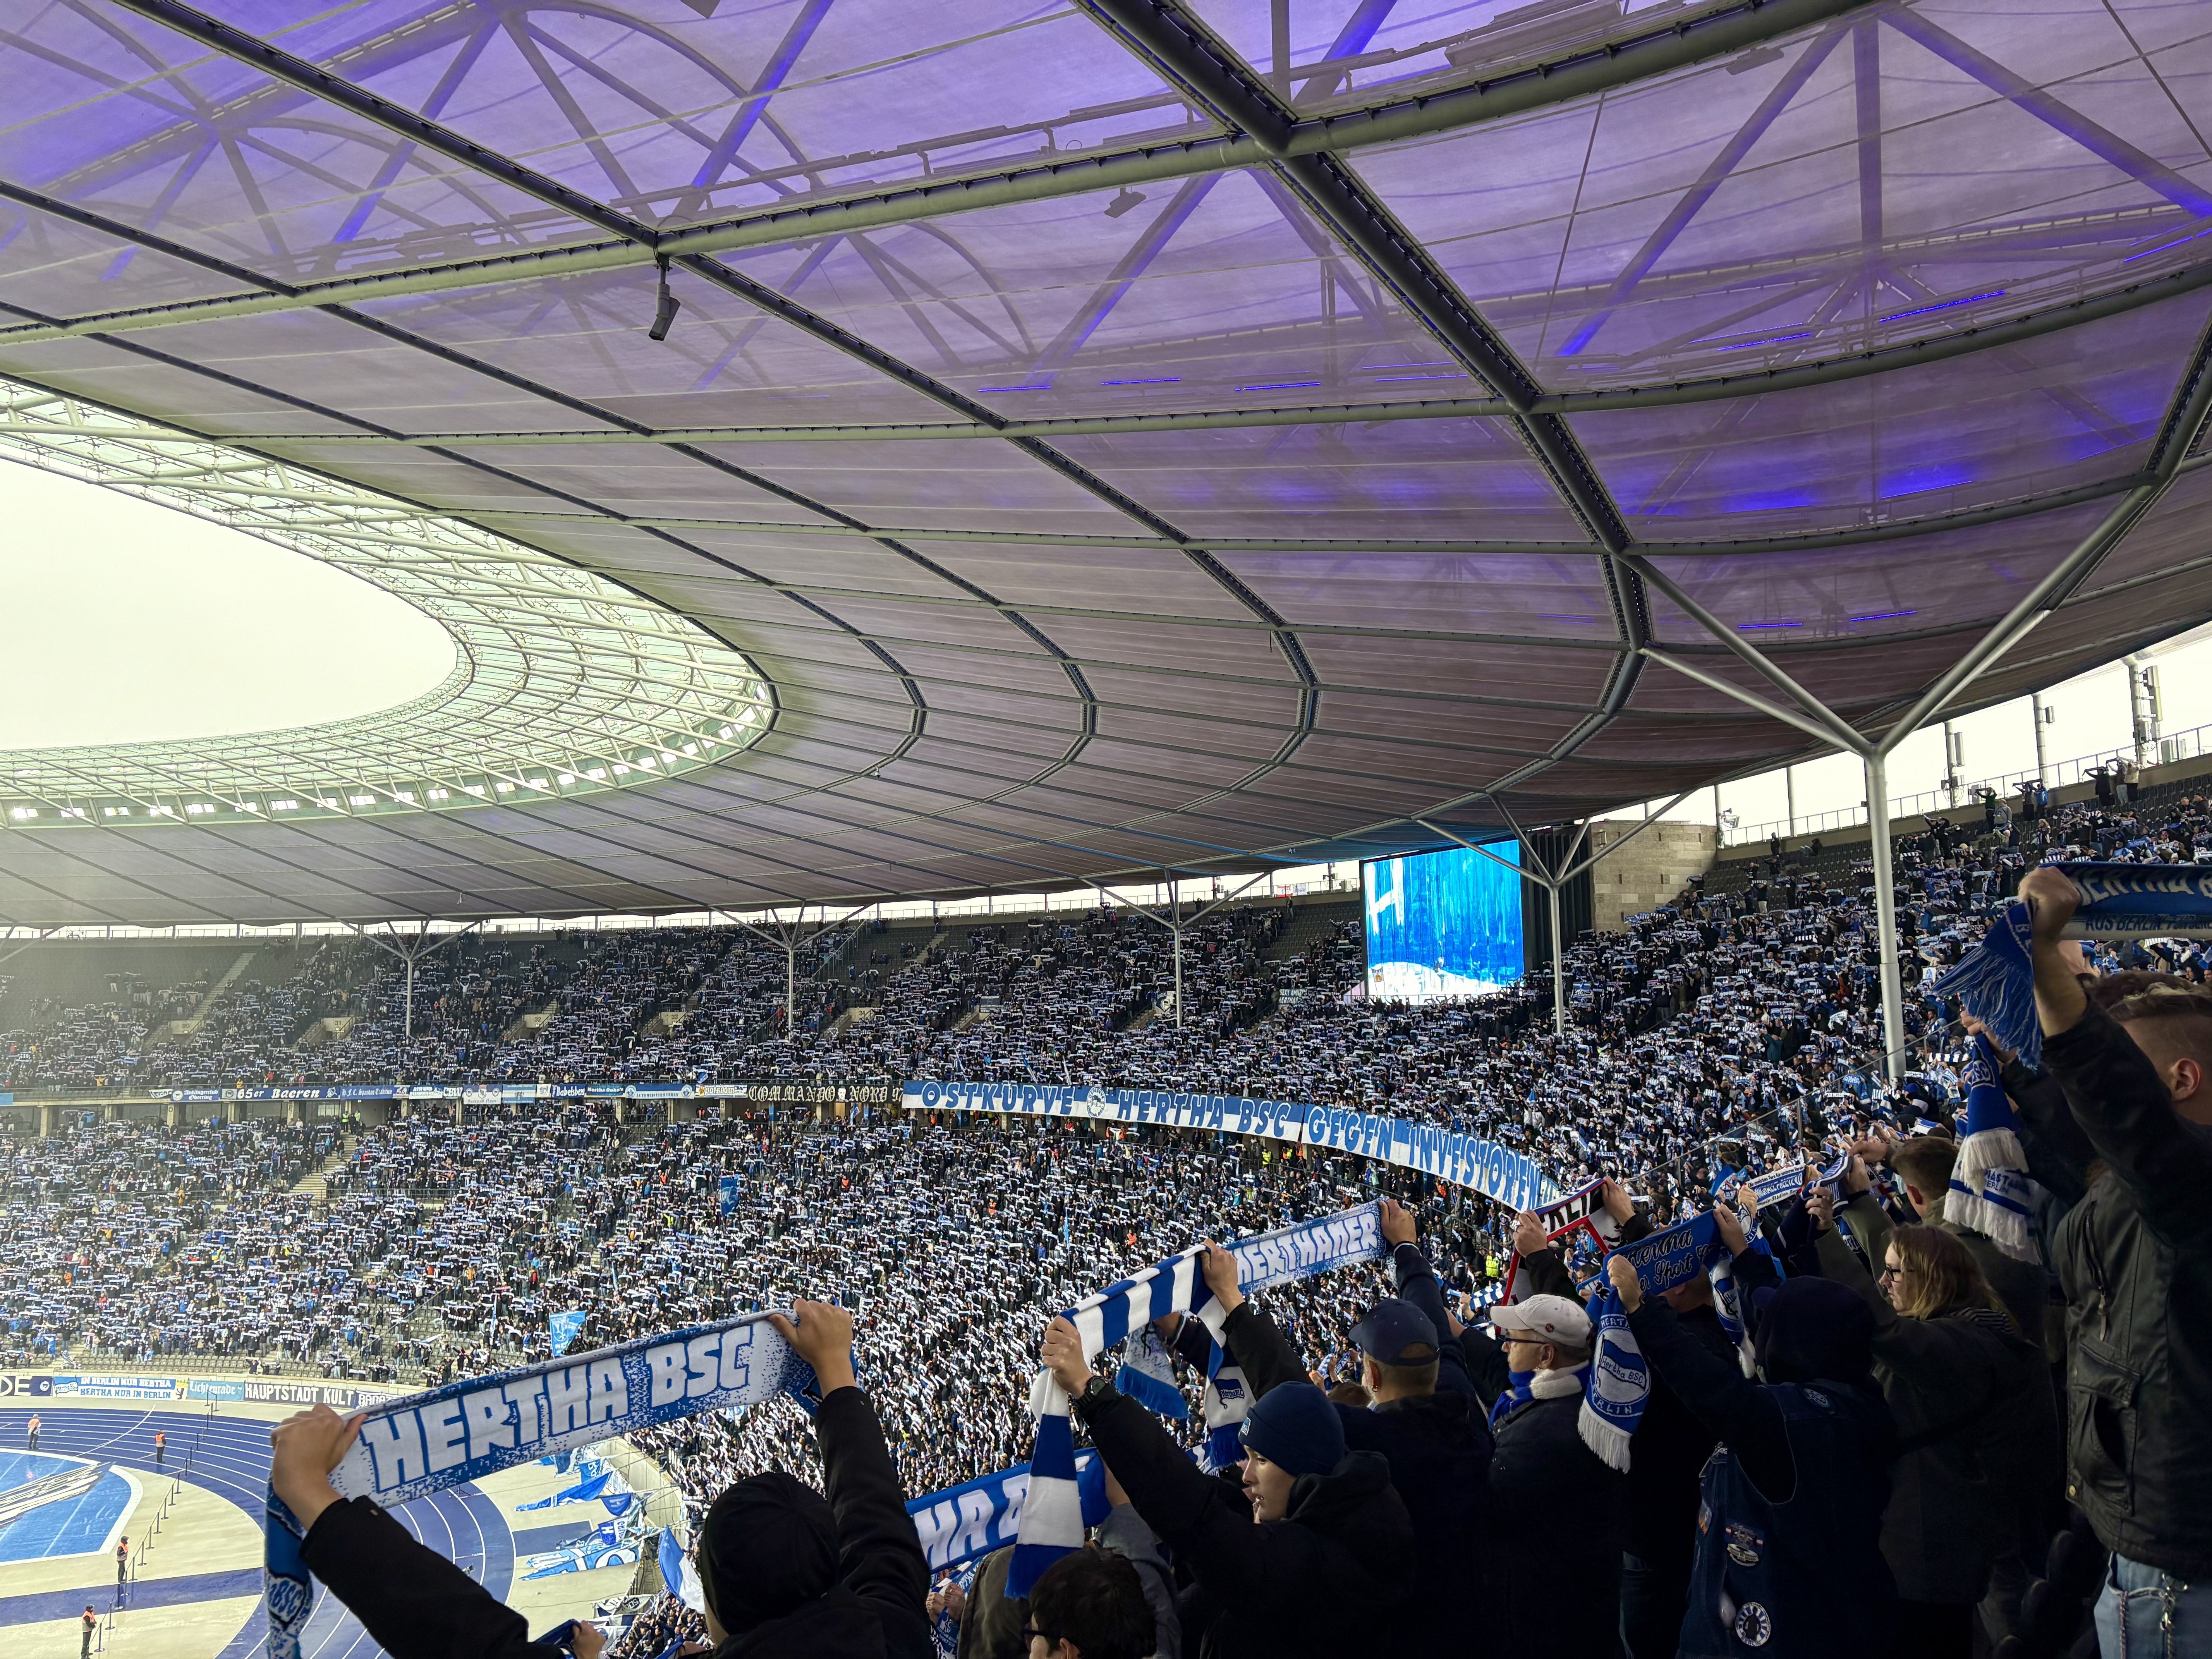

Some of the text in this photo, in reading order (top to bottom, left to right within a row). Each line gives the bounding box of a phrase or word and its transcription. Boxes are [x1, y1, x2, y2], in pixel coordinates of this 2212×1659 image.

[271, 1088, 320, 1099] Baeren
[443, 1086, 463, 1097] CBW
[556, 1085, 585, 1097] Babelsberg
[705, 1085, 735, 1095] potsdam
[748, 1085, 836, 1103] COMMANDO
[849, 1085, 888, 1103] NORD
[921, 1081, 1542, 1211] OSTKURVE HERTHA BSC GEGEN INVESTOREN
[1654, 1253, 1694, 1289] Sport
[1601, 1356, 1644, 1384] Hertha BSC
[80, 1377, 172, 1388] IN BERLIN NUR HERTHA
[189, 1380, 236, 1395] Lichtenrade
[80, 1388, 112, 1396] HERTHA
[114, 1389, 131, 1397] NUR
[143, 1391, 171, 1399] BERLIN
[245, 1382, 354, 1406] HAUPTSTADT KULT
[361, 1323, 754, 1494] HERTHA BSC
